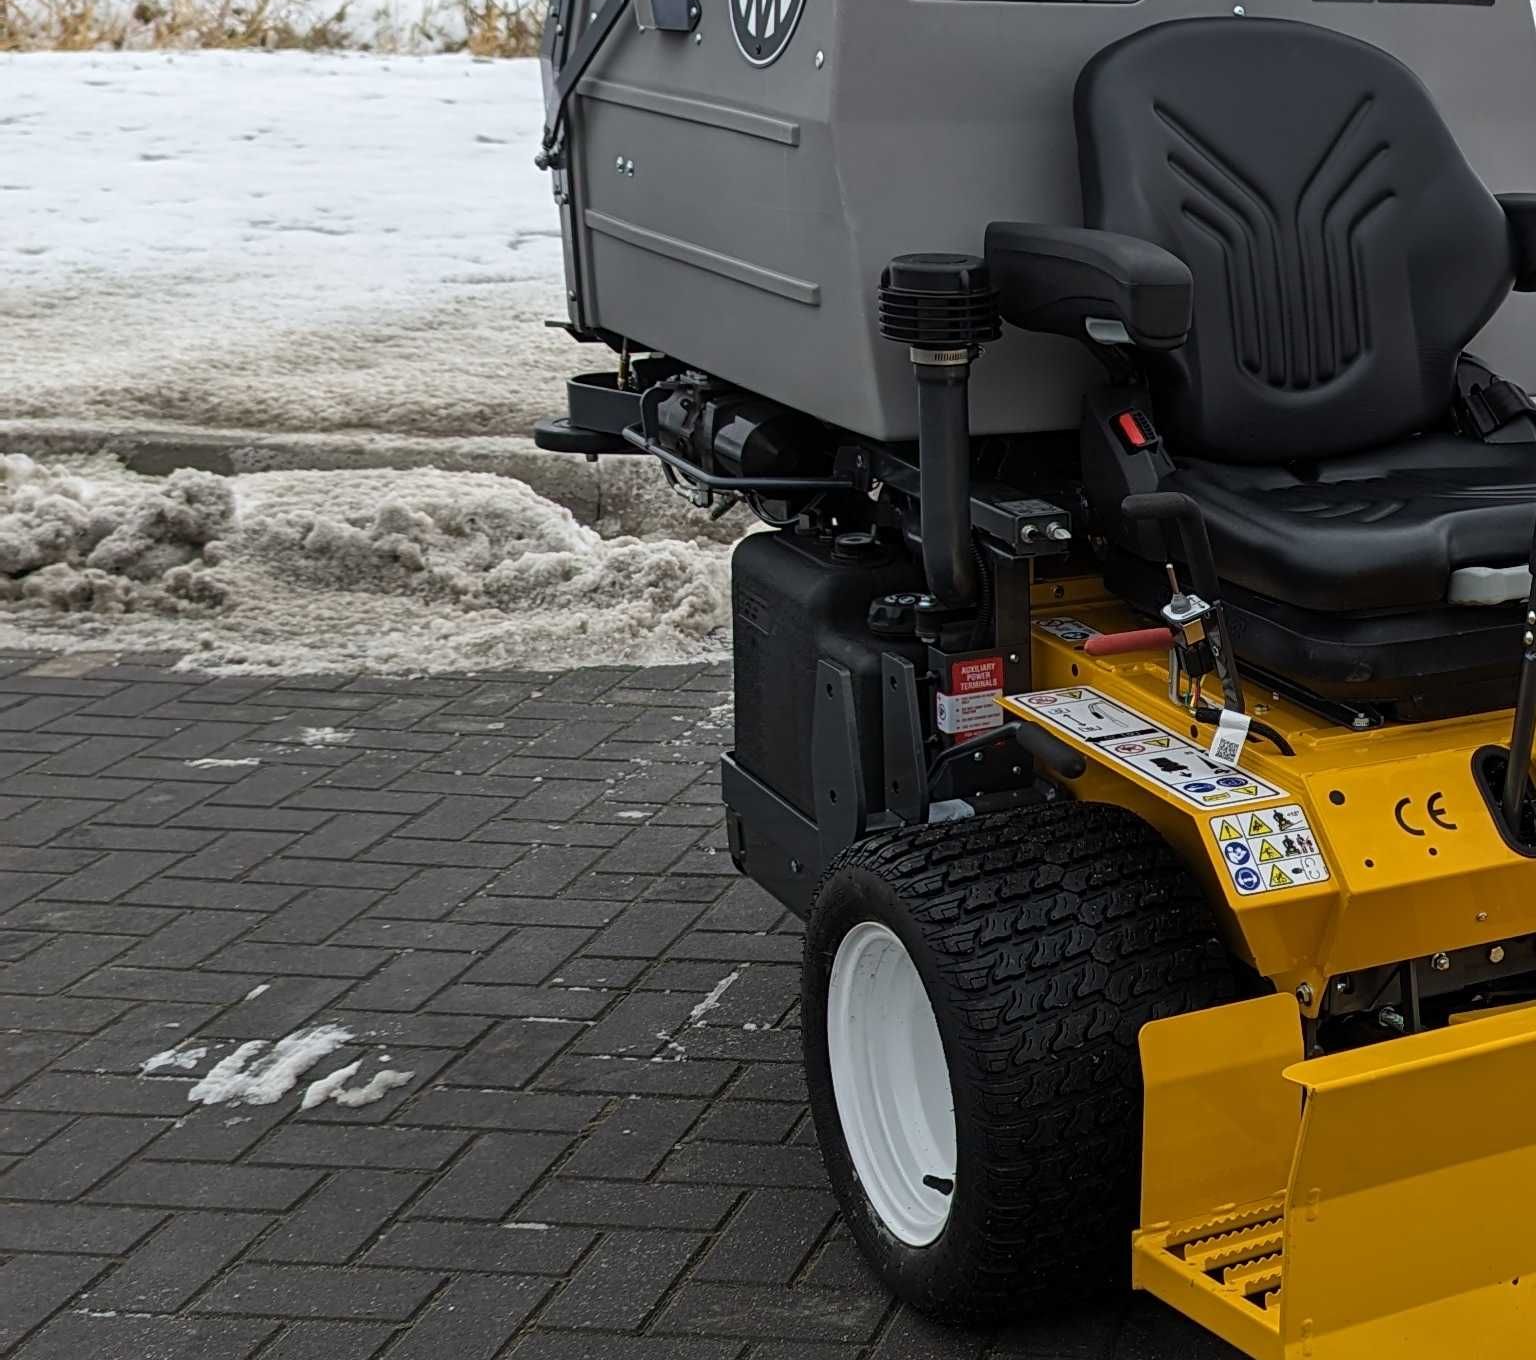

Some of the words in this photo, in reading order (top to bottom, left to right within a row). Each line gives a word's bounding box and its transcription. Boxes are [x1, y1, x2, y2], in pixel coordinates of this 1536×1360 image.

[961, 663, 995, 674] AUXILIARY
[966, 671, 991, 682] POWER
[960, 678, 997, 691] TERMINALS
